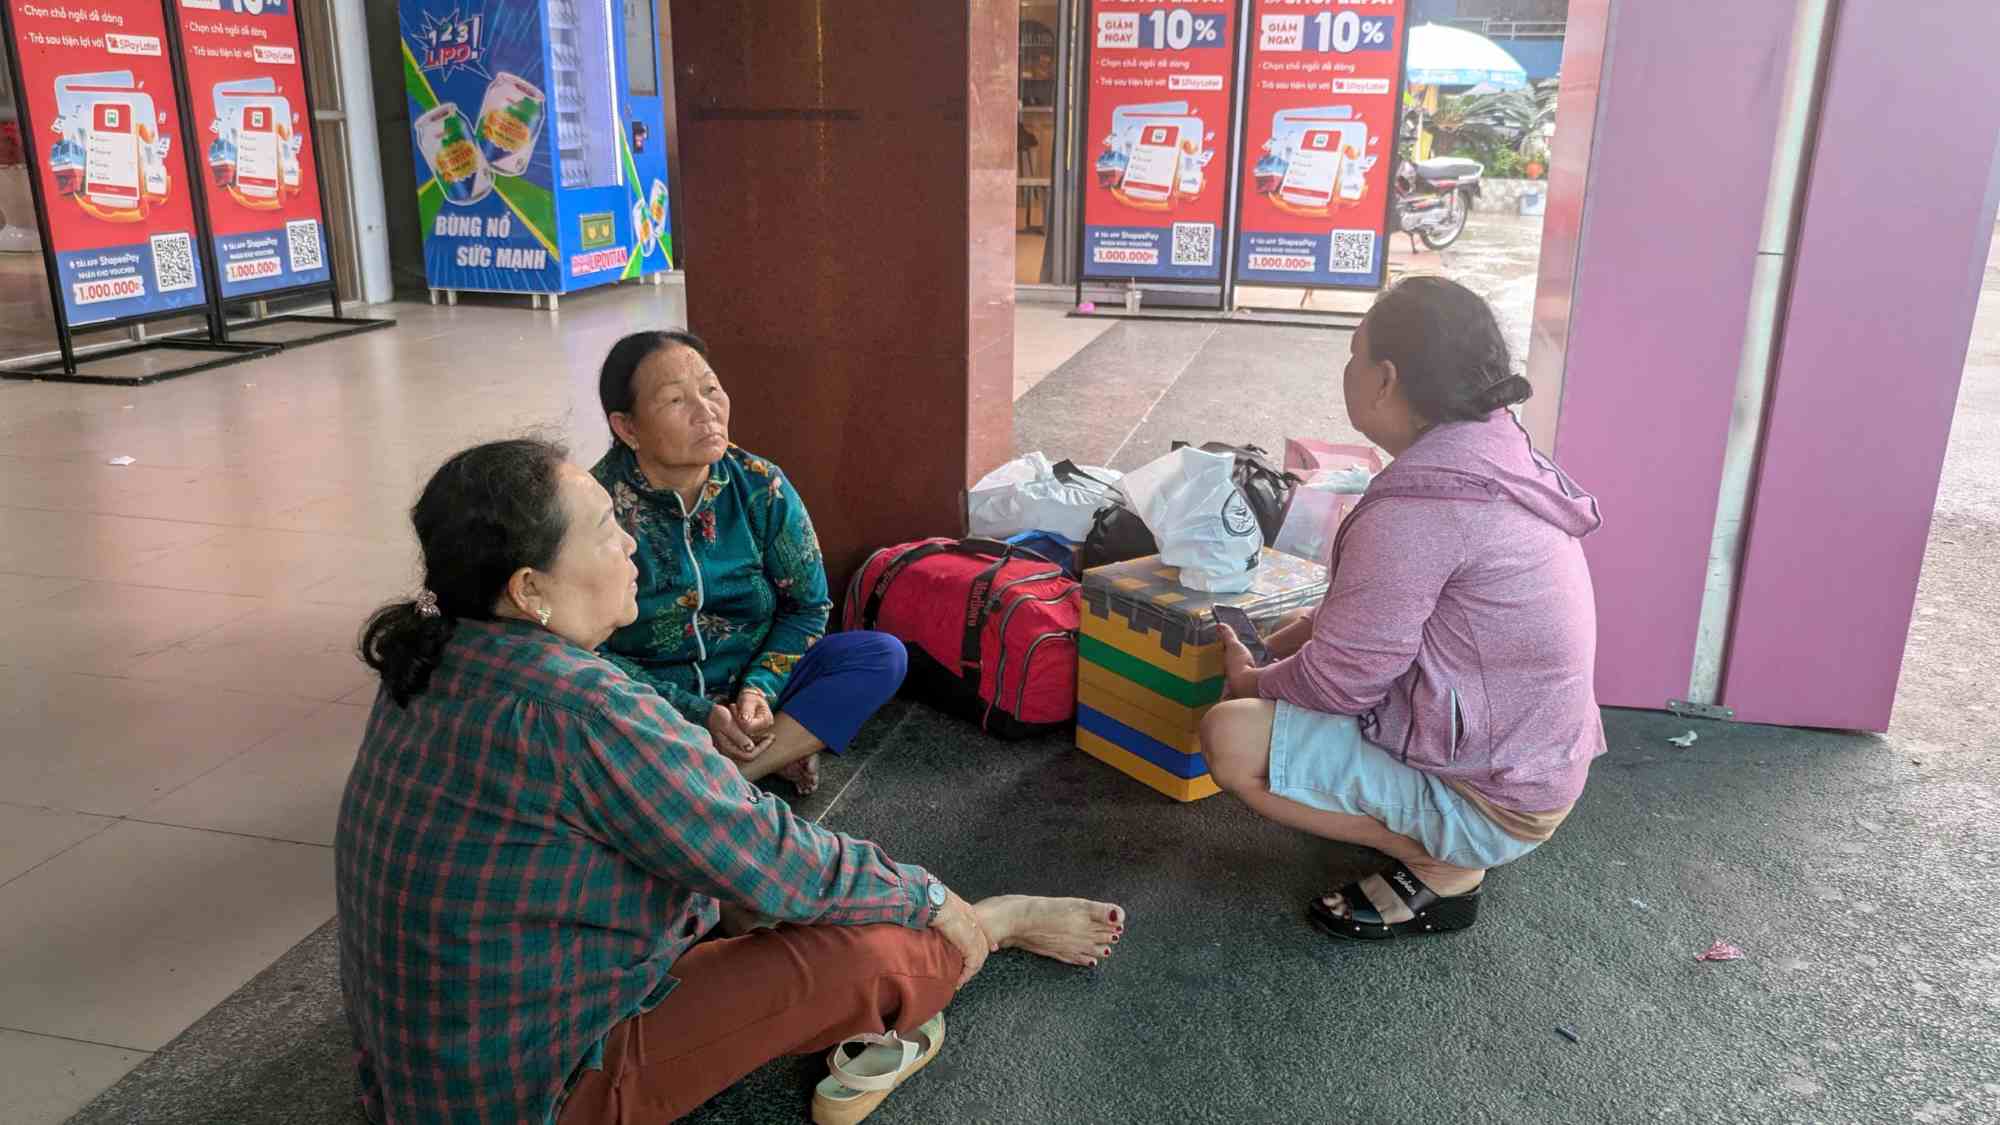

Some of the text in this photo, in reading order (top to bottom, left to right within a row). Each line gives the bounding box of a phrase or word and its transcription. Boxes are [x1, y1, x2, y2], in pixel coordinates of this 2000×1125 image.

[1104, 33, 1133, 42] NGAY
[1267, 35, 1296, 44] NGAY
[495, 247, 546, 272] MẠNH
